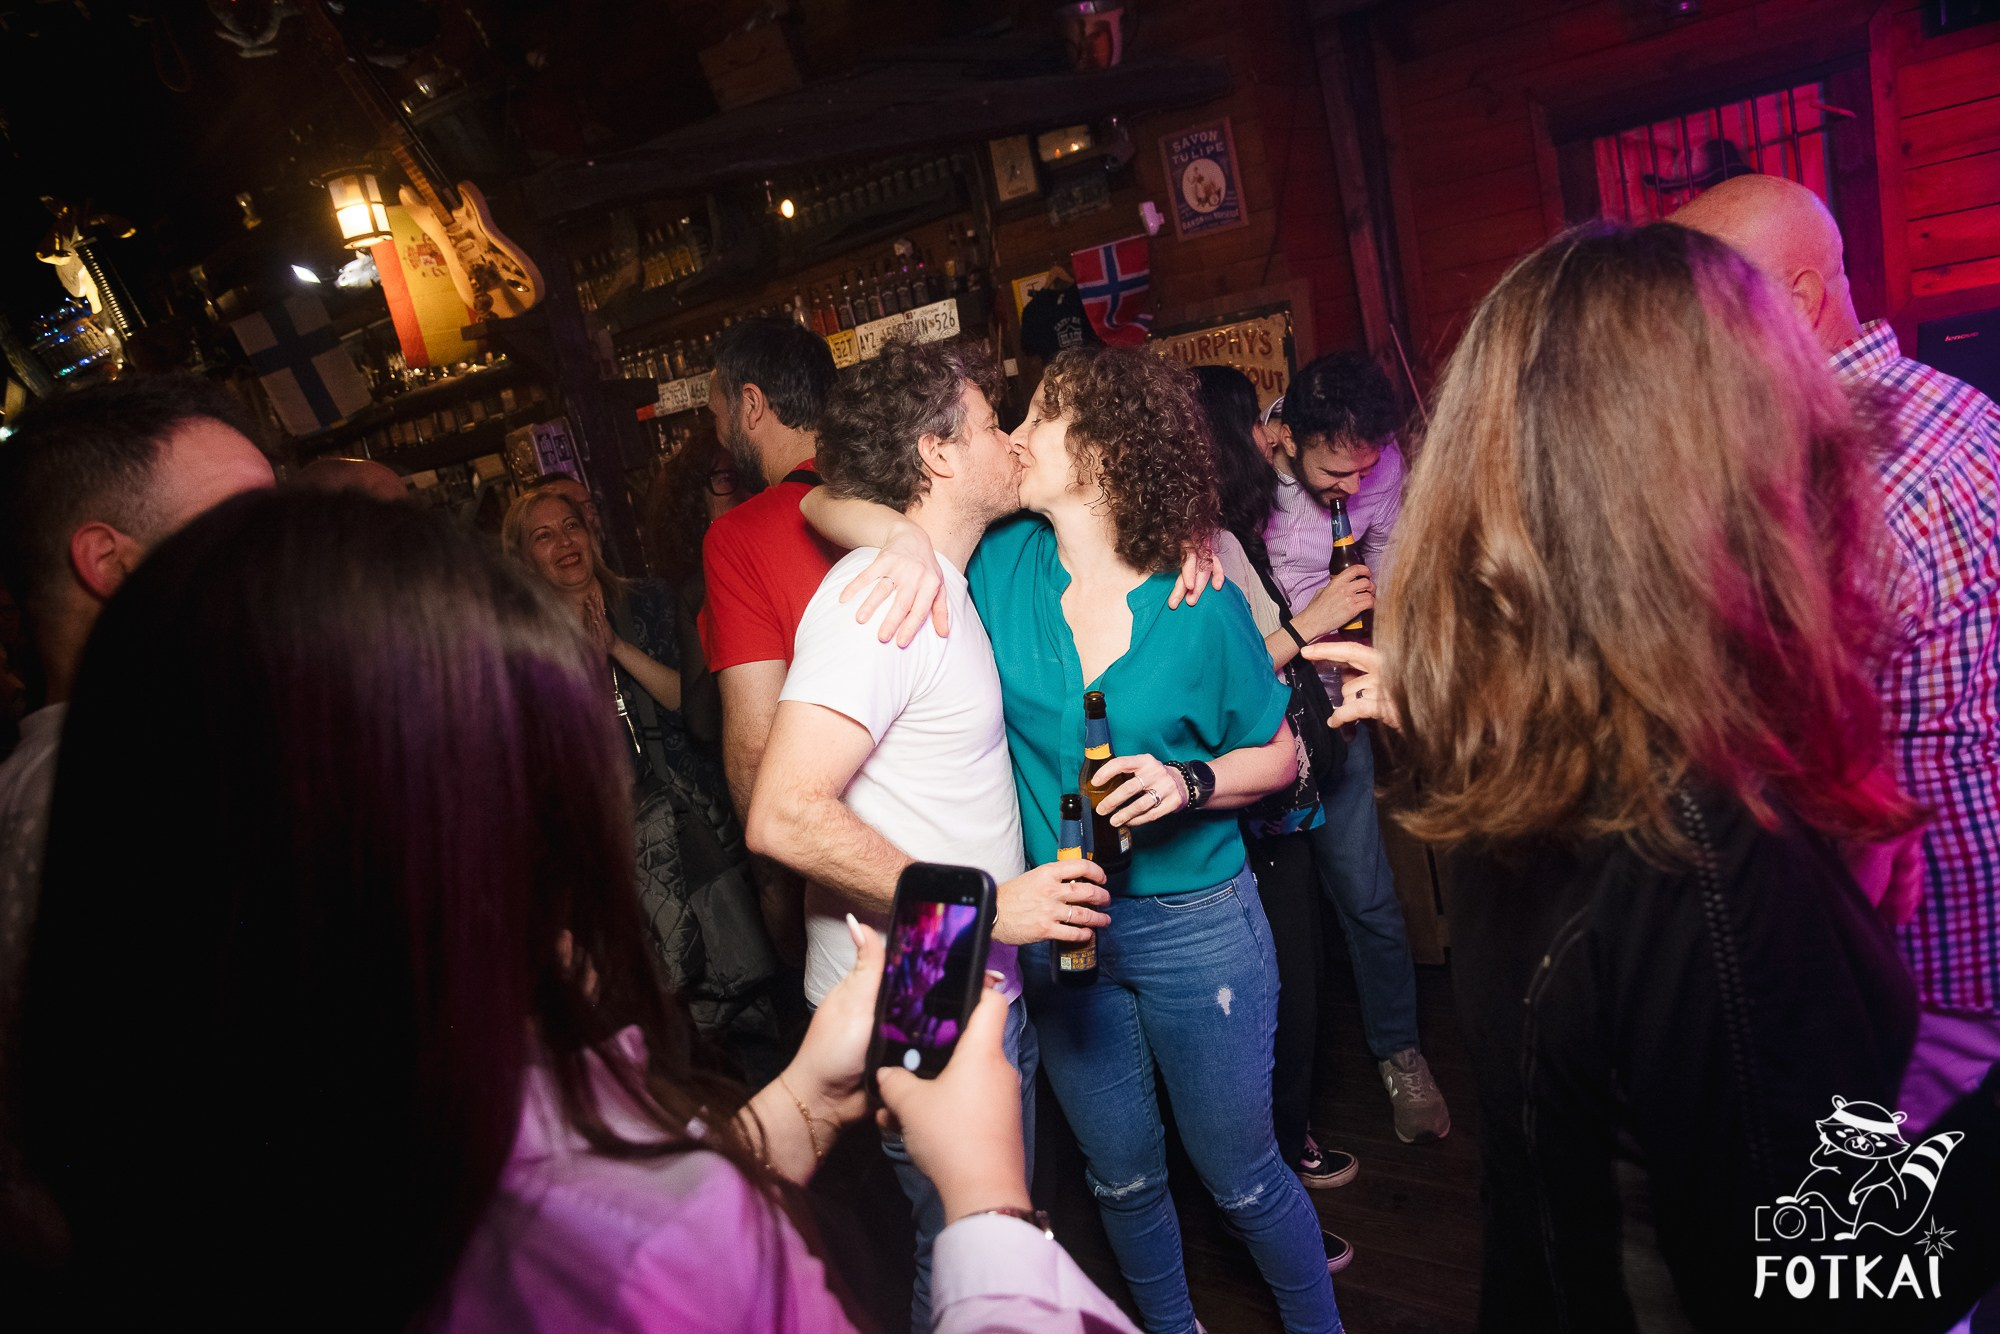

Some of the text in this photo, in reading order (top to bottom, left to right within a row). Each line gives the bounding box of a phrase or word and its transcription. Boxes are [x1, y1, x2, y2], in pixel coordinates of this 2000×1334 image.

[1172, 130, 1219, 153] SAVON
[1171, 142, 1225, 165] TULIPE
[934, 312, 956, 331] 526
